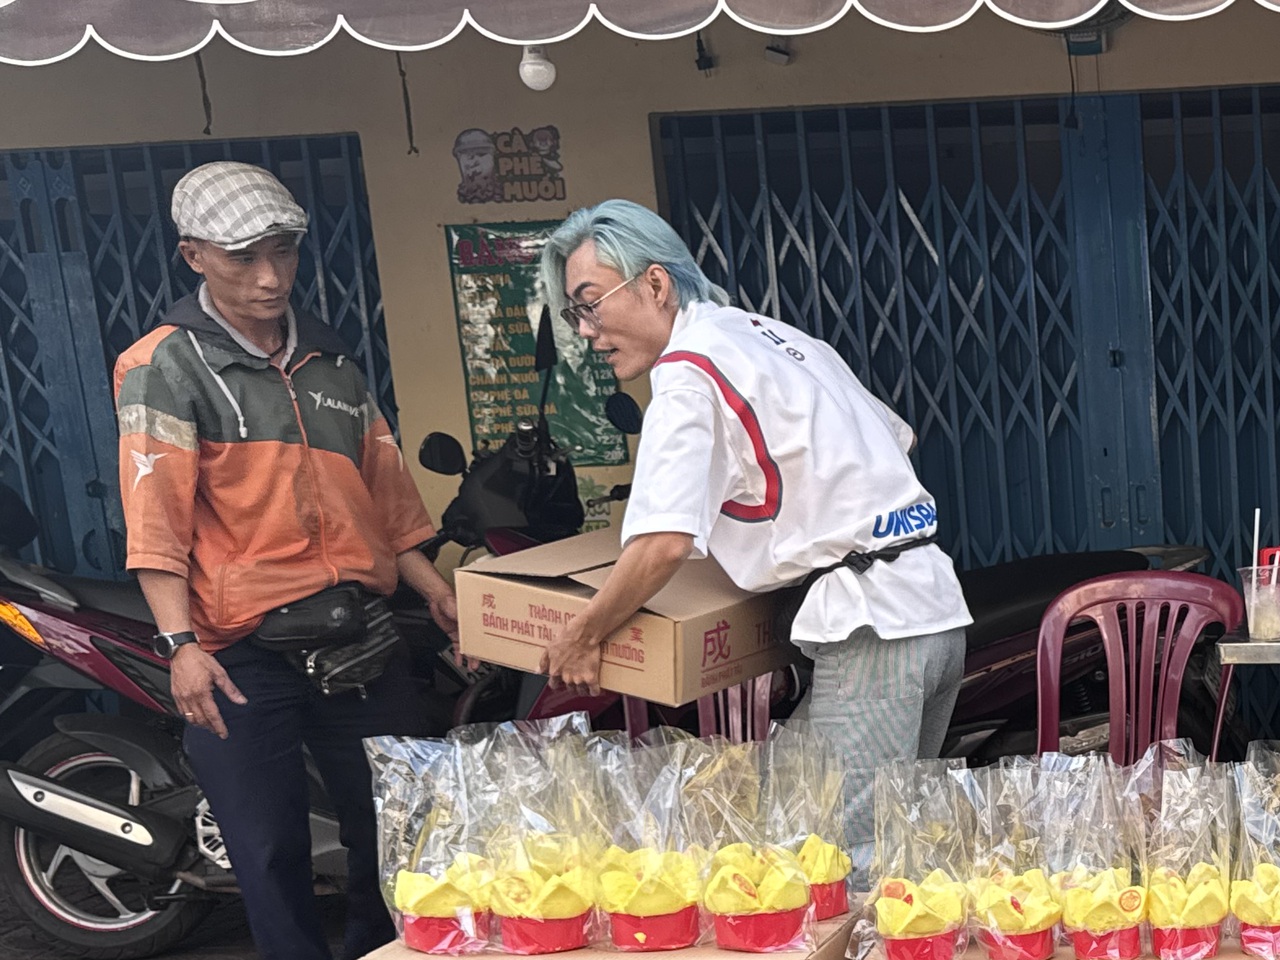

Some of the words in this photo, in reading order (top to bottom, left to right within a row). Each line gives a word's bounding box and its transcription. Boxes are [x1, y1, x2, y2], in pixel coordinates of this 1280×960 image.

[496, 128, 528, 152] CÀ
[511, 620, 535, 636] PHÁT
[537, 624, 552, 641] TÀI
[702, 619, 731, 668] 成
